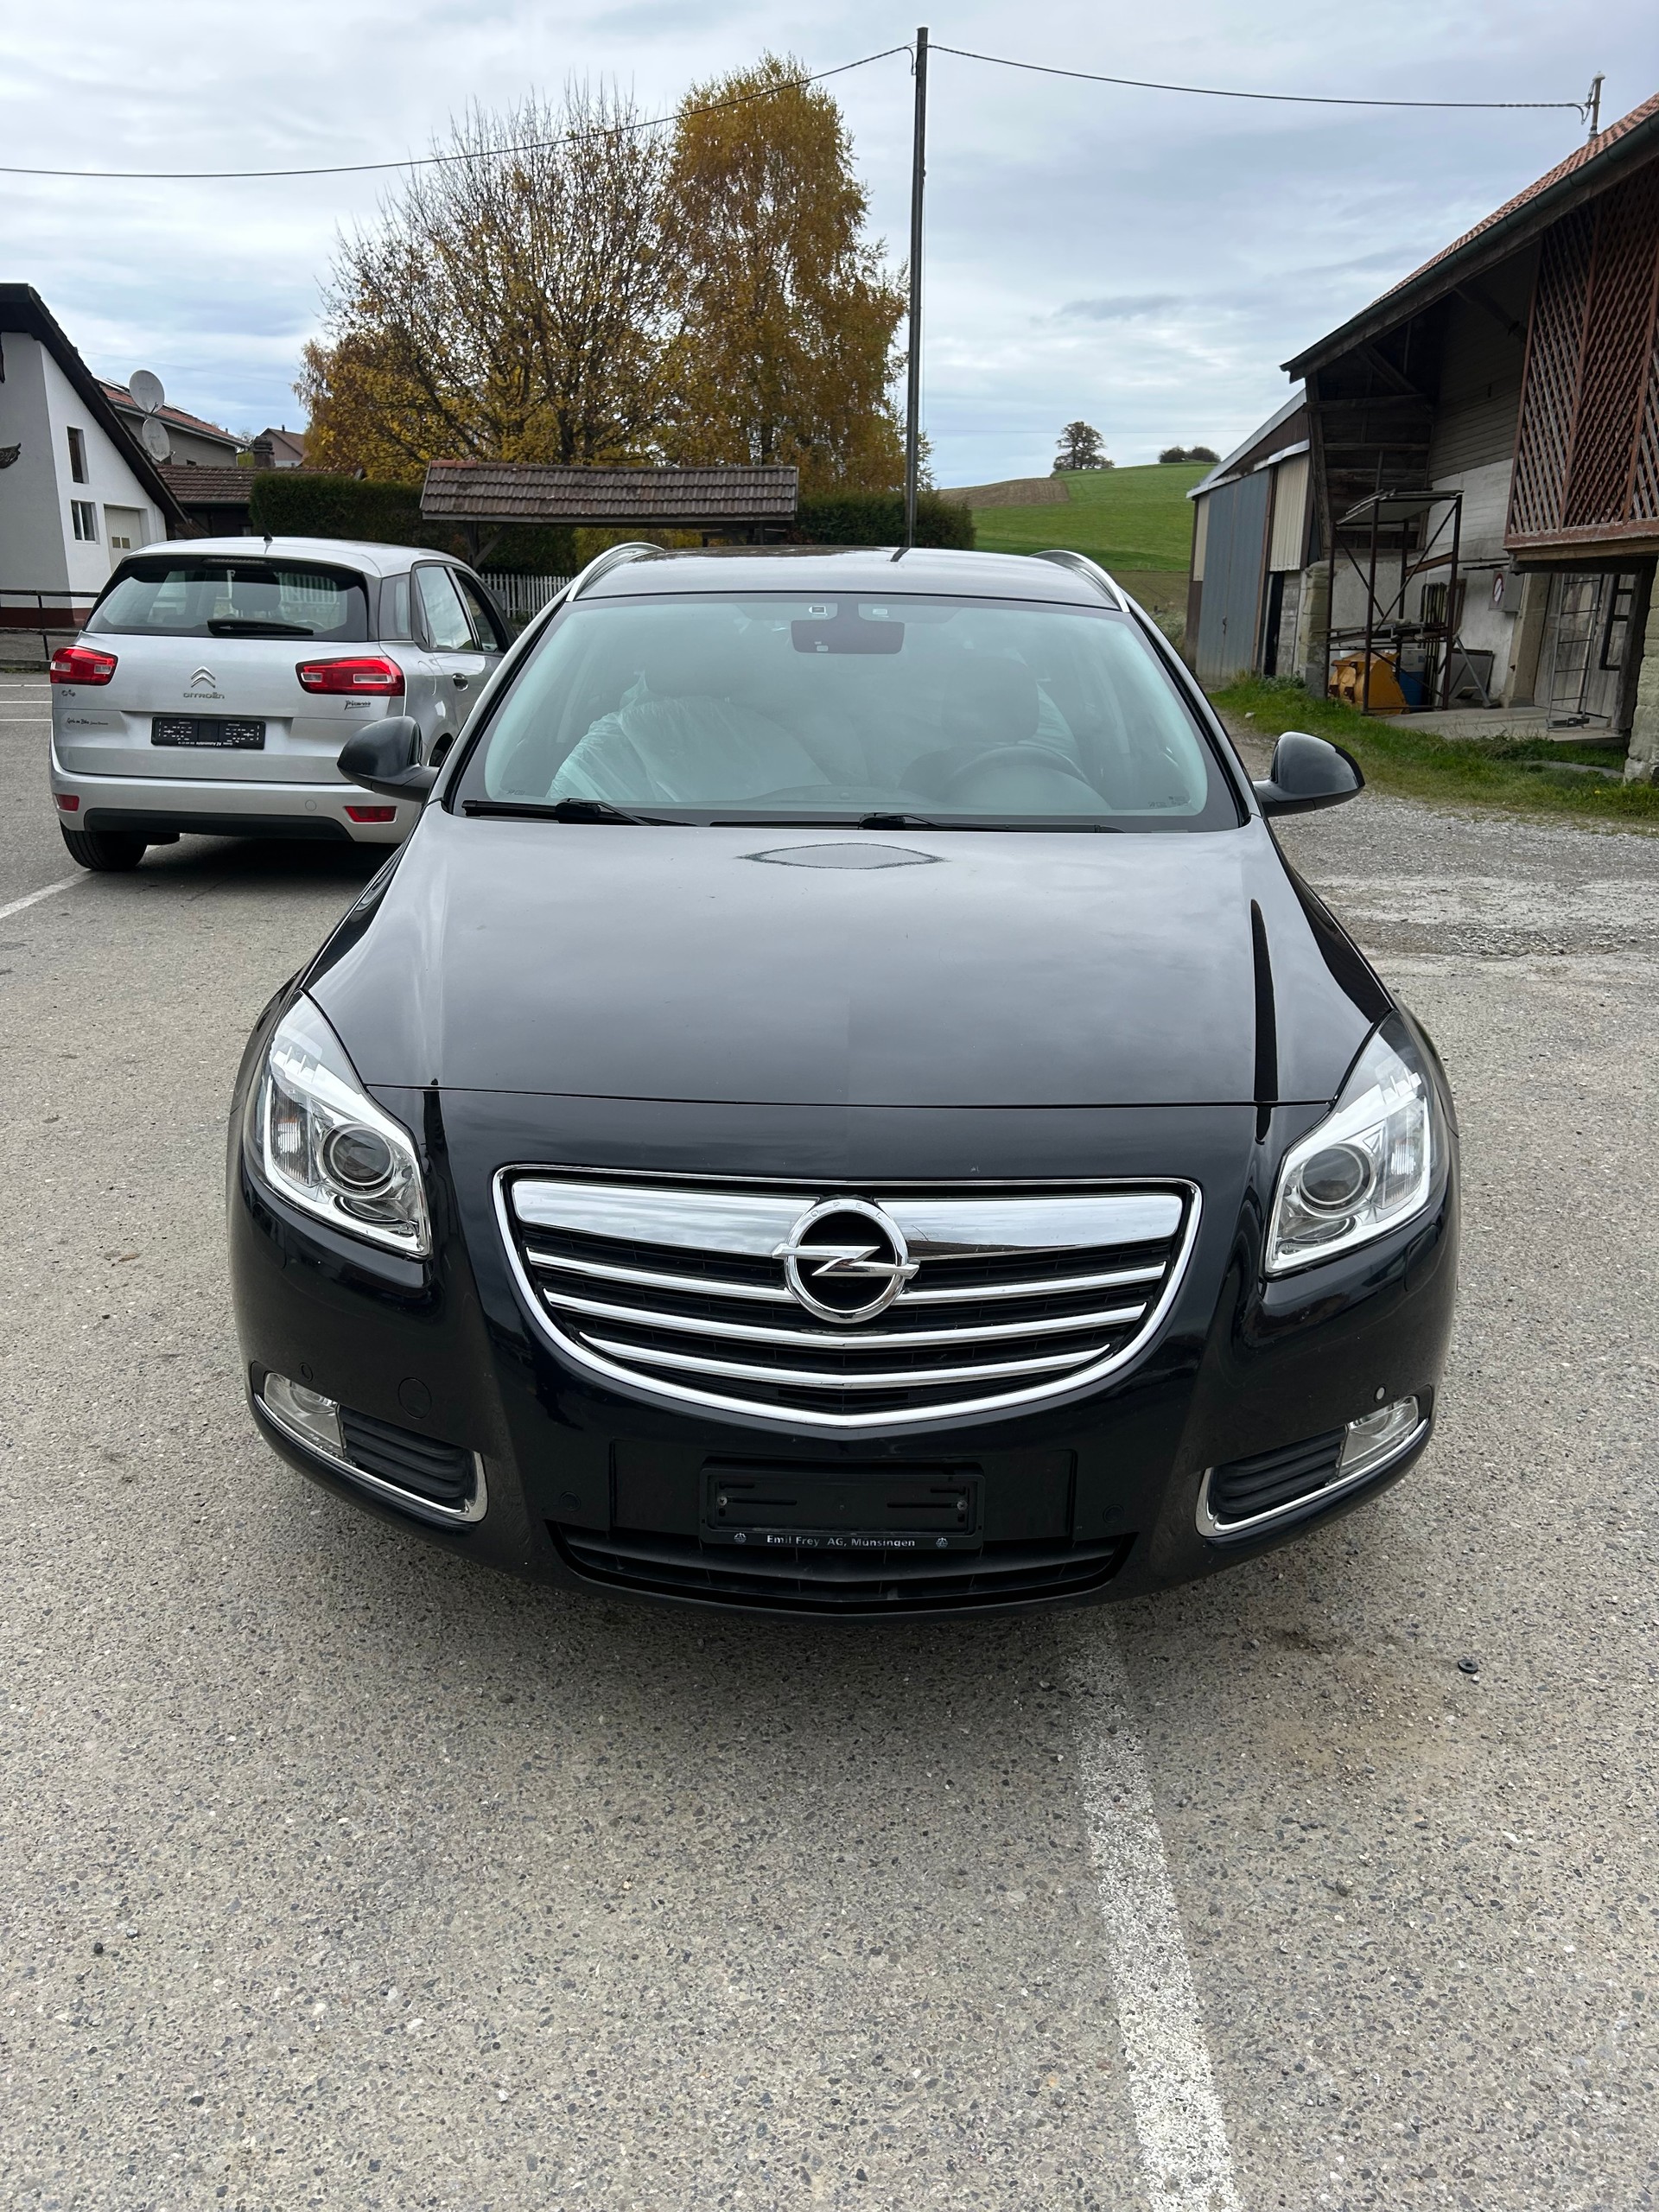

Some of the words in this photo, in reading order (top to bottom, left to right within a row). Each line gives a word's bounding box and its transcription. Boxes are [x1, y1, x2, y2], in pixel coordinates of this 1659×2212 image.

[810, 1201, 883, 1220] OPEL
[767, 1535, 791, 1544] Emil
[796, 1536, 819, 1547] Frey
[828, 1538, 847, 1547] AG,
